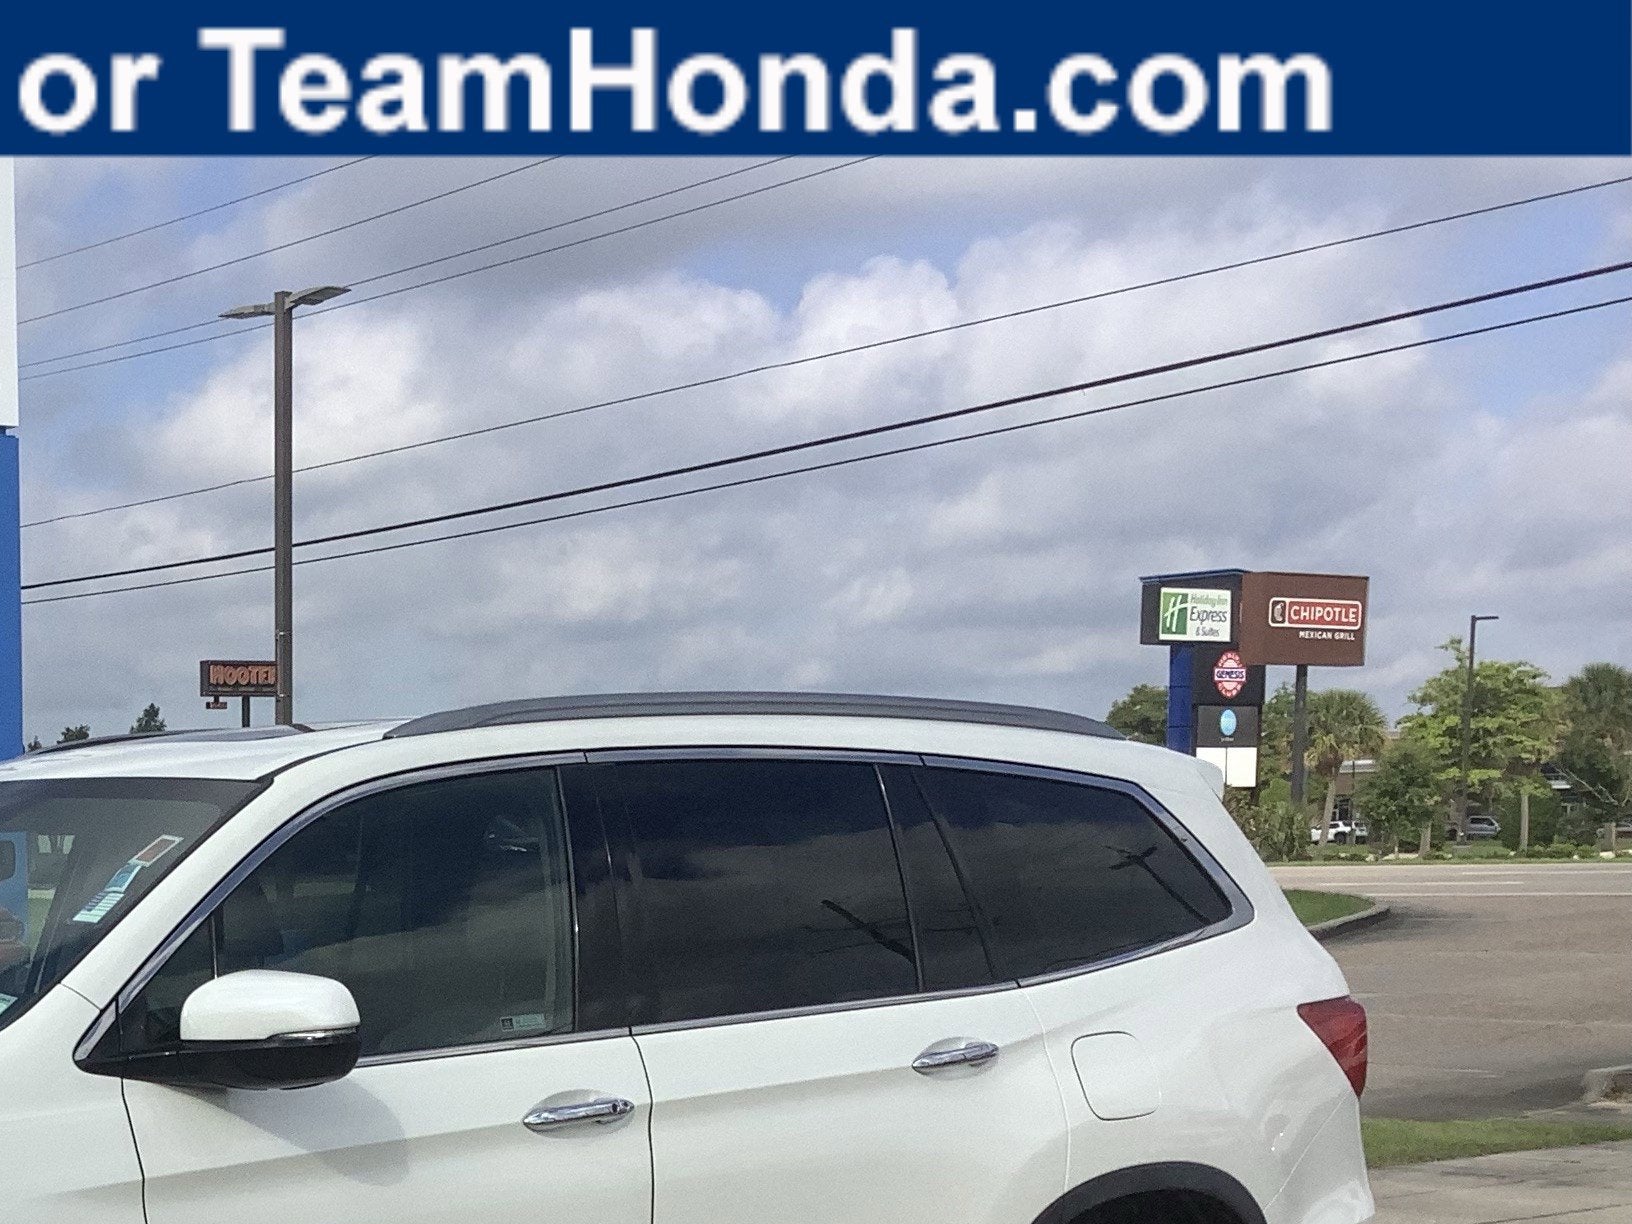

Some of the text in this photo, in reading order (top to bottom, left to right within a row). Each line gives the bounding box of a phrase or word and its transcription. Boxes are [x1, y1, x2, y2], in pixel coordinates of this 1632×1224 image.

[1189, 606, 1228, 625] Express
[1289, 605, 1358, 623] CHIPOTLE
[1201, 626, 1220, 637] Suites
[1298, 630, 1355, 641] MEXICAN GRILL
